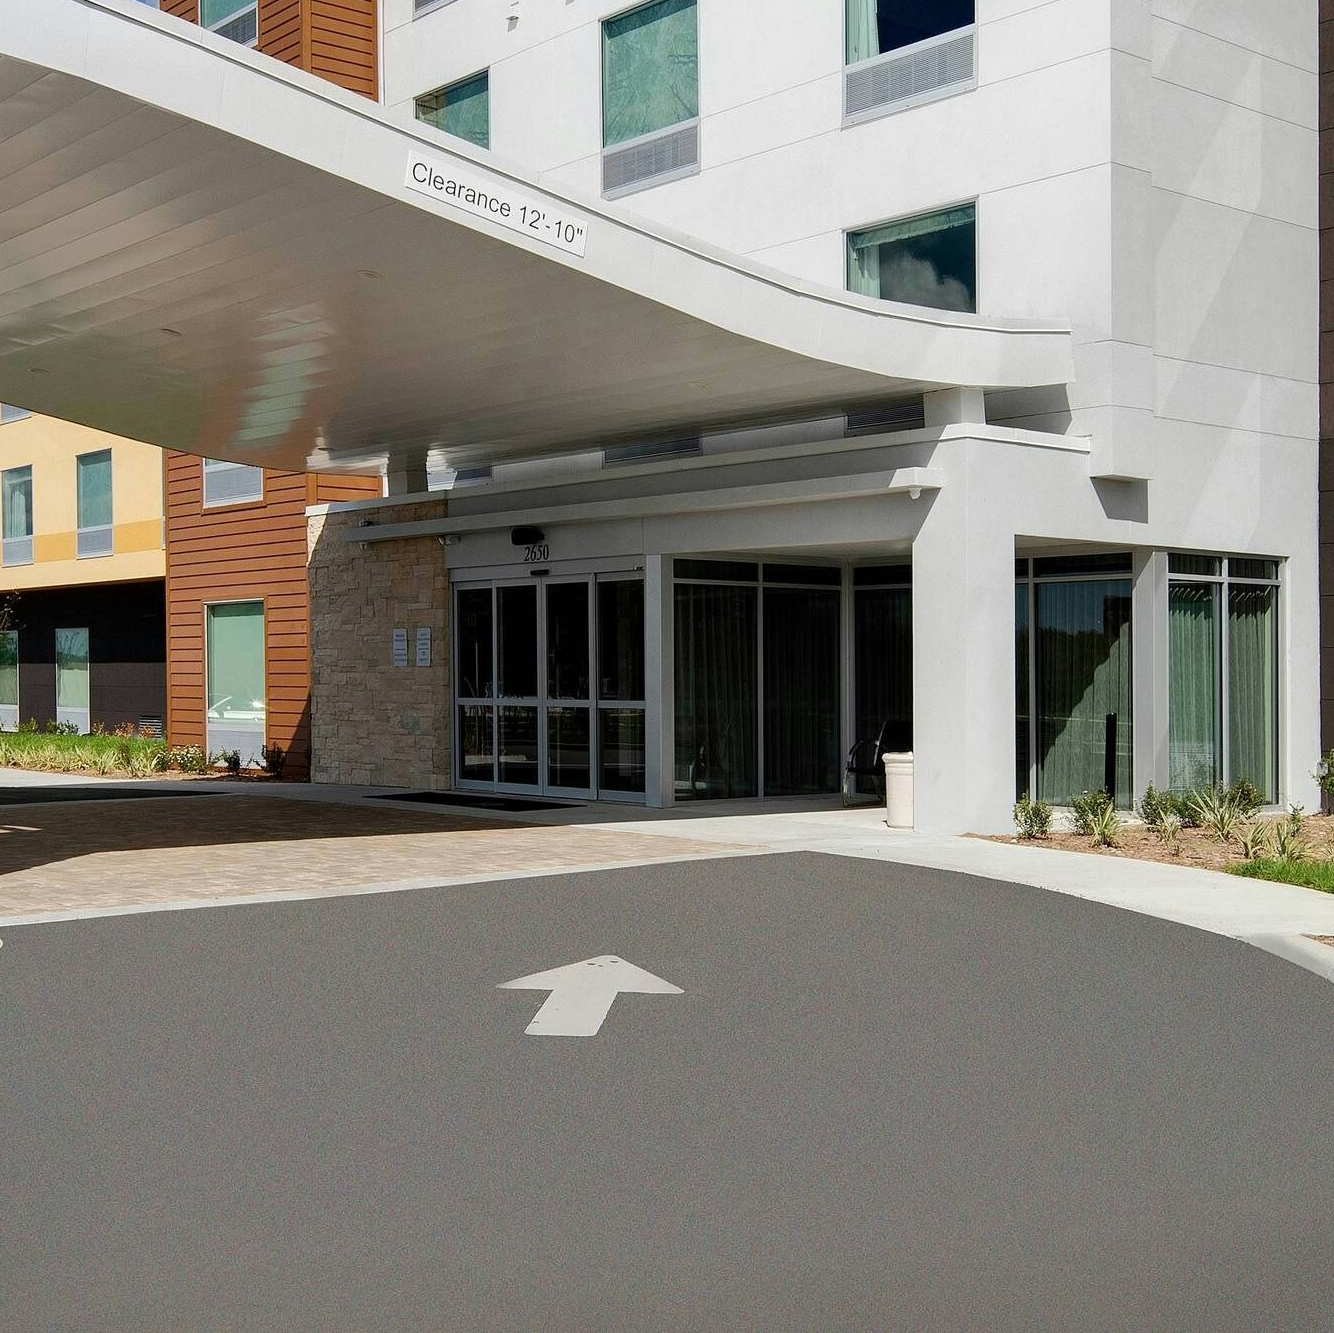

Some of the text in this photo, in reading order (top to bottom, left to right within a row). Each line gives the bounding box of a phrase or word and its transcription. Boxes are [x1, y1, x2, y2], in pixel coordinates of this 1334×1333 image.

[412, 162, 583, 243] Clearance 12'-10"
[524, 544, 550, 562] 2650
